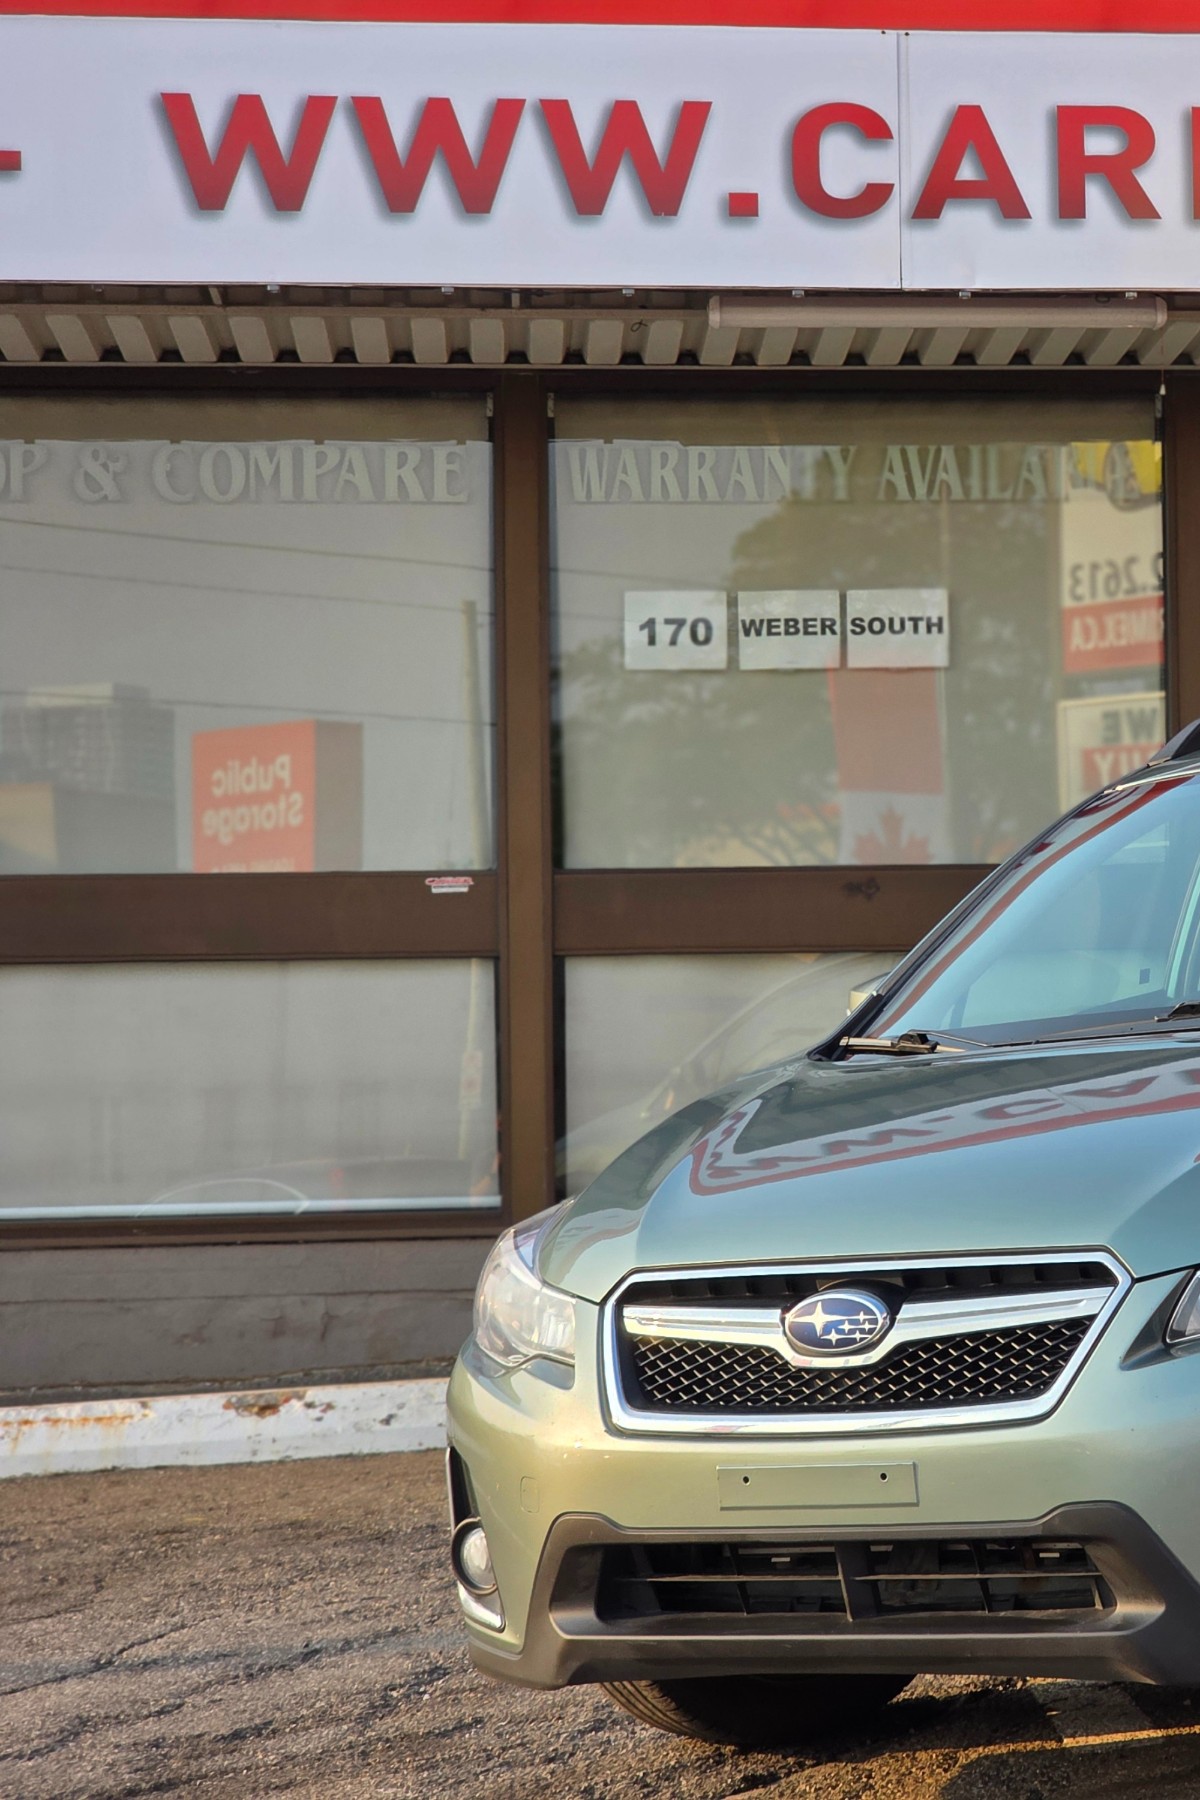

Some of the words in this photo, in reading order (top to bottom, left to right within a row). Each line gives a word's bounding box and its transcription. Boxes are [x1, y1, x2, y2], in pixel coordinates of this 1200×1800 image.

[0, 444, 49, 501] P
[75, 445, 127, 501] &
[153, 444, 469, 502] COMPARE
[566, 445, 858, 502] WARRANTY
[638, 617, 714, 647] 170
[741, 616, 838, 637] WEBER
[850, 615, 944, 636] SOUTH
